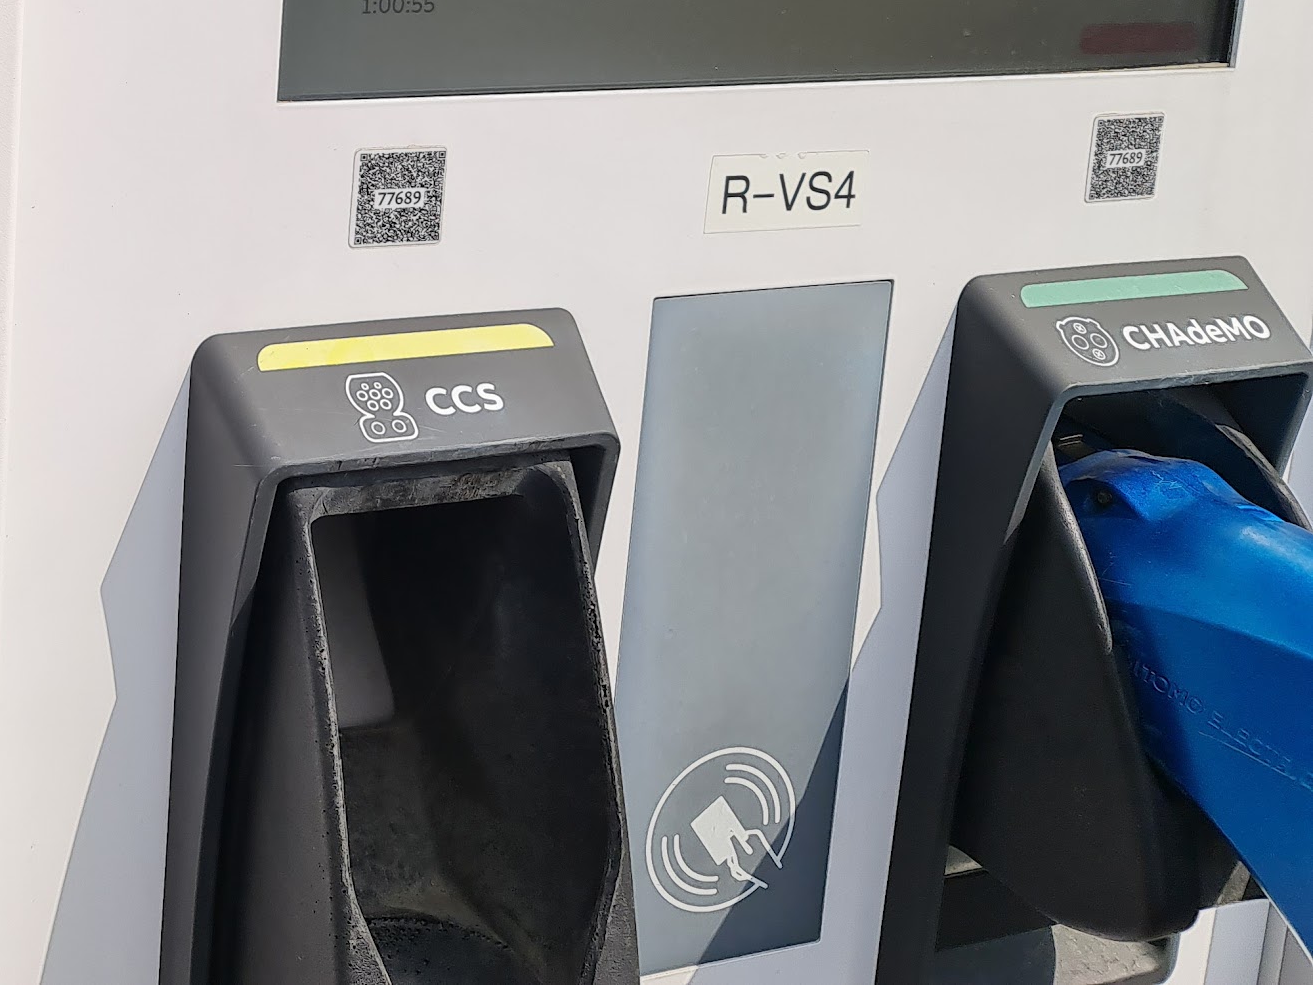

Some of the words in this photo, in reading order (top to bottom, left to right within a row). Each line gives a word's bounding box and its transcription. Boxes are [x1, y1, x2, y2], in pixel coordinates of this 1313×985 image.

[1108, 151, 1143, 166] 77689
[377, 190, 422, 206] 77689
[721, 170, 857, 214] R-VS4
[1122, 314, 1271, 351] CHAdeMO
[425, 383, 505, 416] CCS
